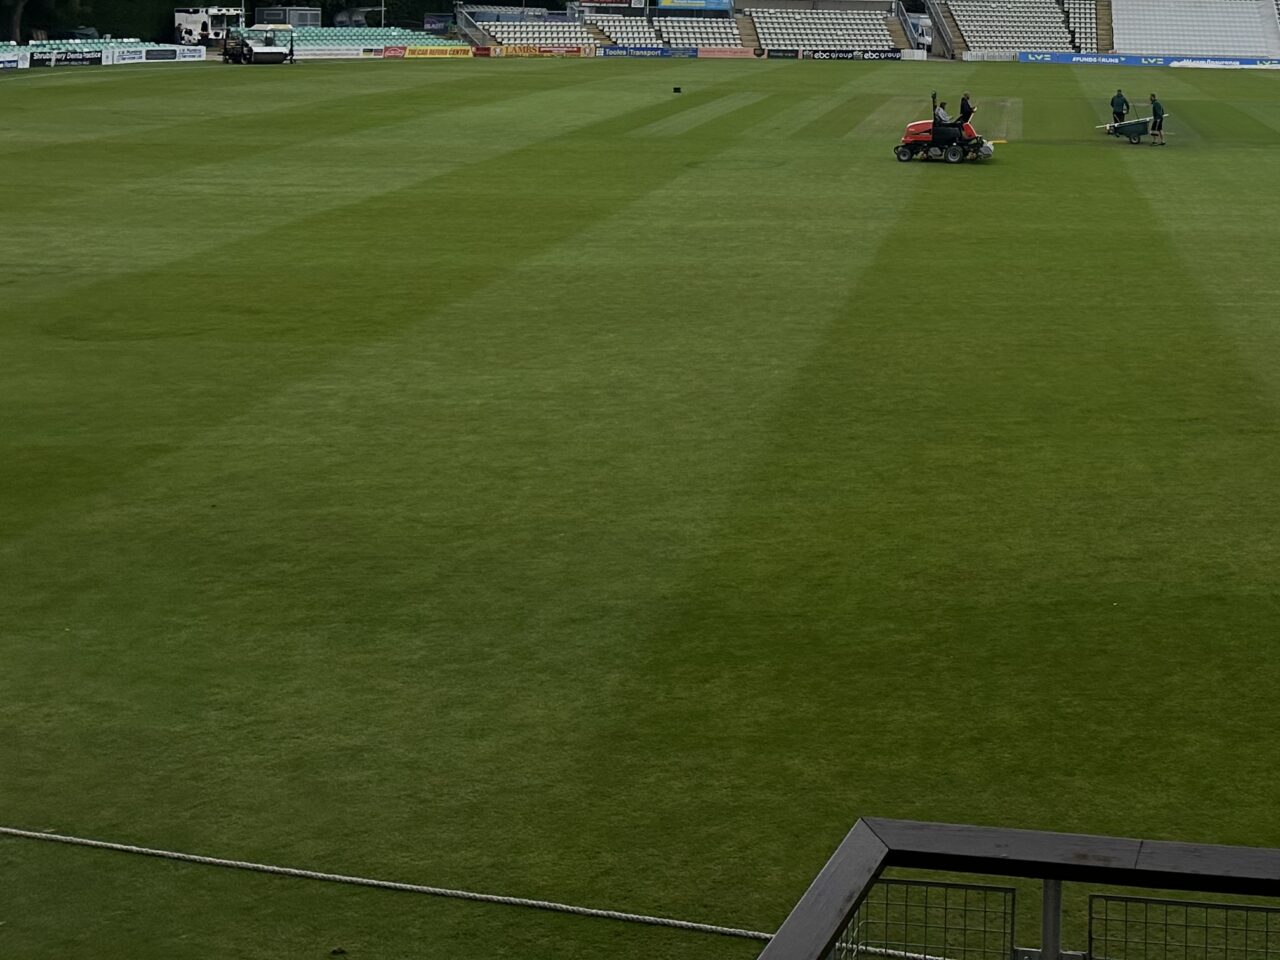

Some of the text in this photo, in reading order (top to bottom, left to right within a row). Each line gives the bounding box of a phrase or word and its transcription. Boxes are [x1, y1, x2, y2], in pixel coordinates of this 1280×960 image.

[33, 52, 67, 60] Shrubery
[629, 47, 661, 56] Transport
[814, 51, 853, 60] ebc group
[864, 51, 902, 60] ebc group
